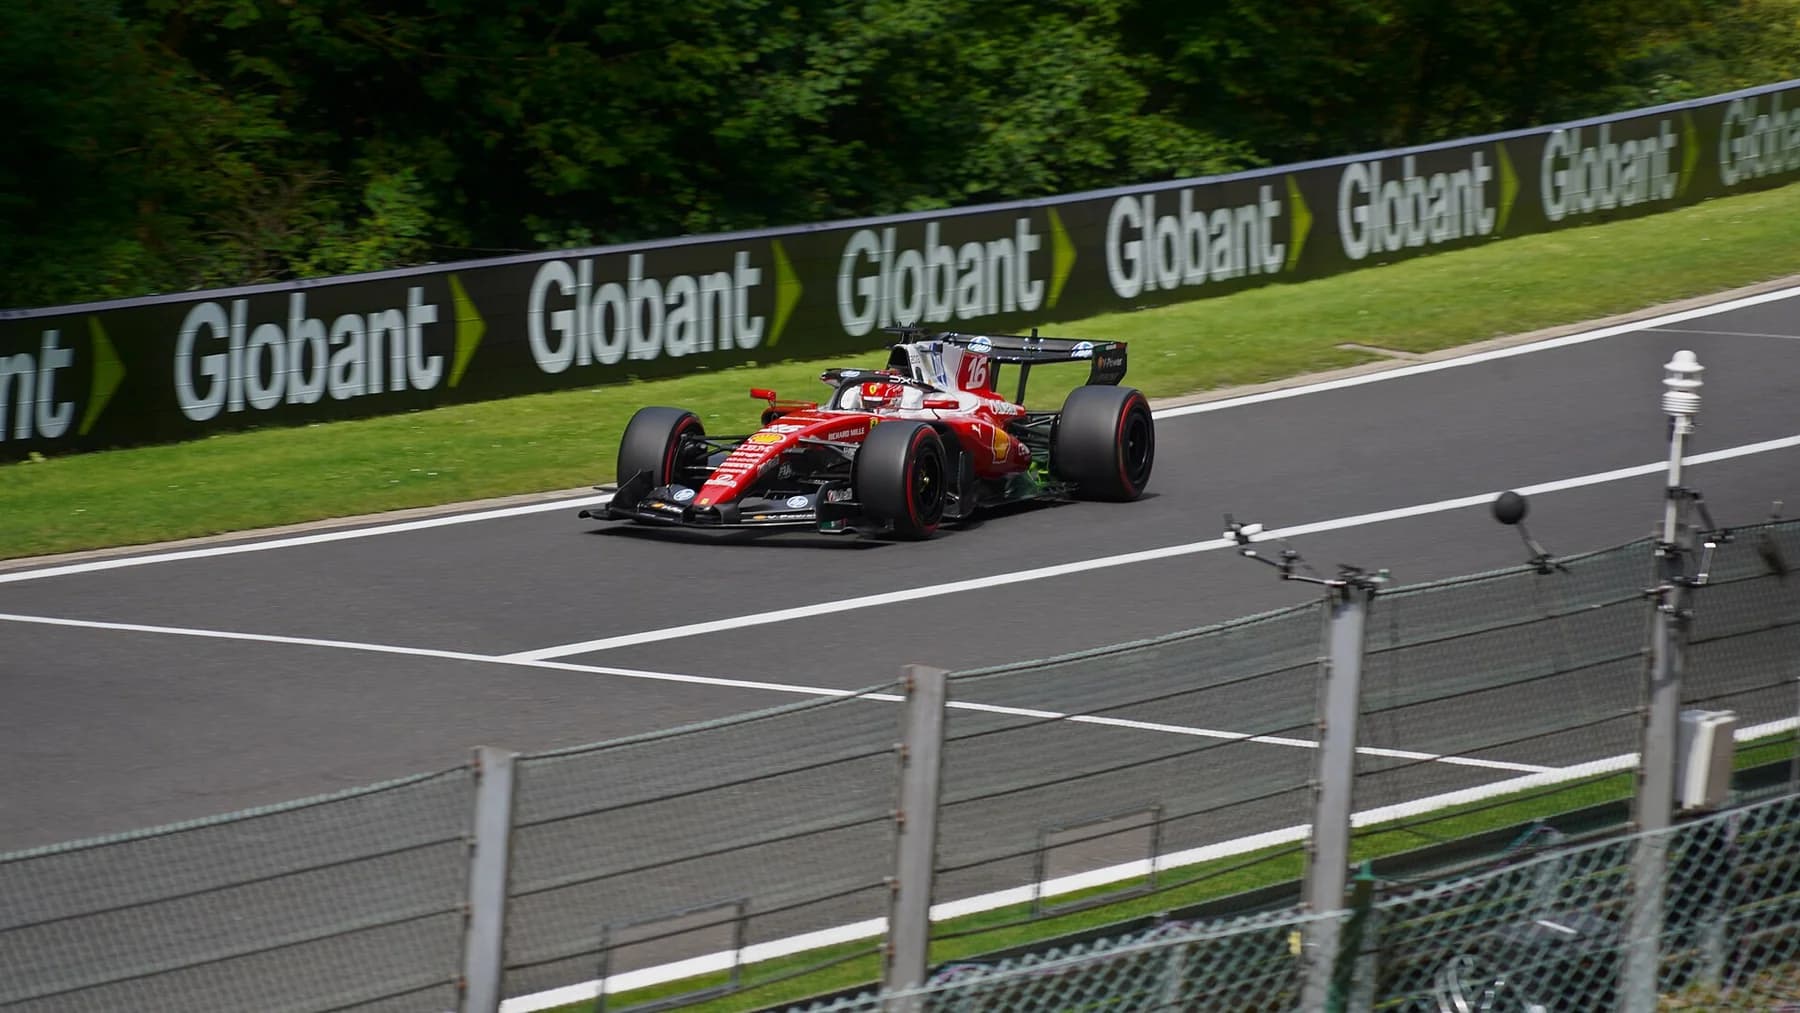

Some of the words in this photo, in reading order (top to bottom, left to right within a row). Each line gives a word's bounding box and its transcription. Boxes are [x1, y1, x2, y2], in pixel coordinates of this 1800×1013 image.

[1338, 151, 1496, 260] Globant
[1540, 120, 1679, 222] Globant
[837, 218, 1045, 336] Globant
[1106, 185, 1285, 297] Globant
[174, 286, 443, 422] Globant
[528, 251, 765, 374] Globant
[966, 356, 988, 390] 16
[828, 430, 850, 441] RICHARD
[850, 427, 865, 438] MILLE
